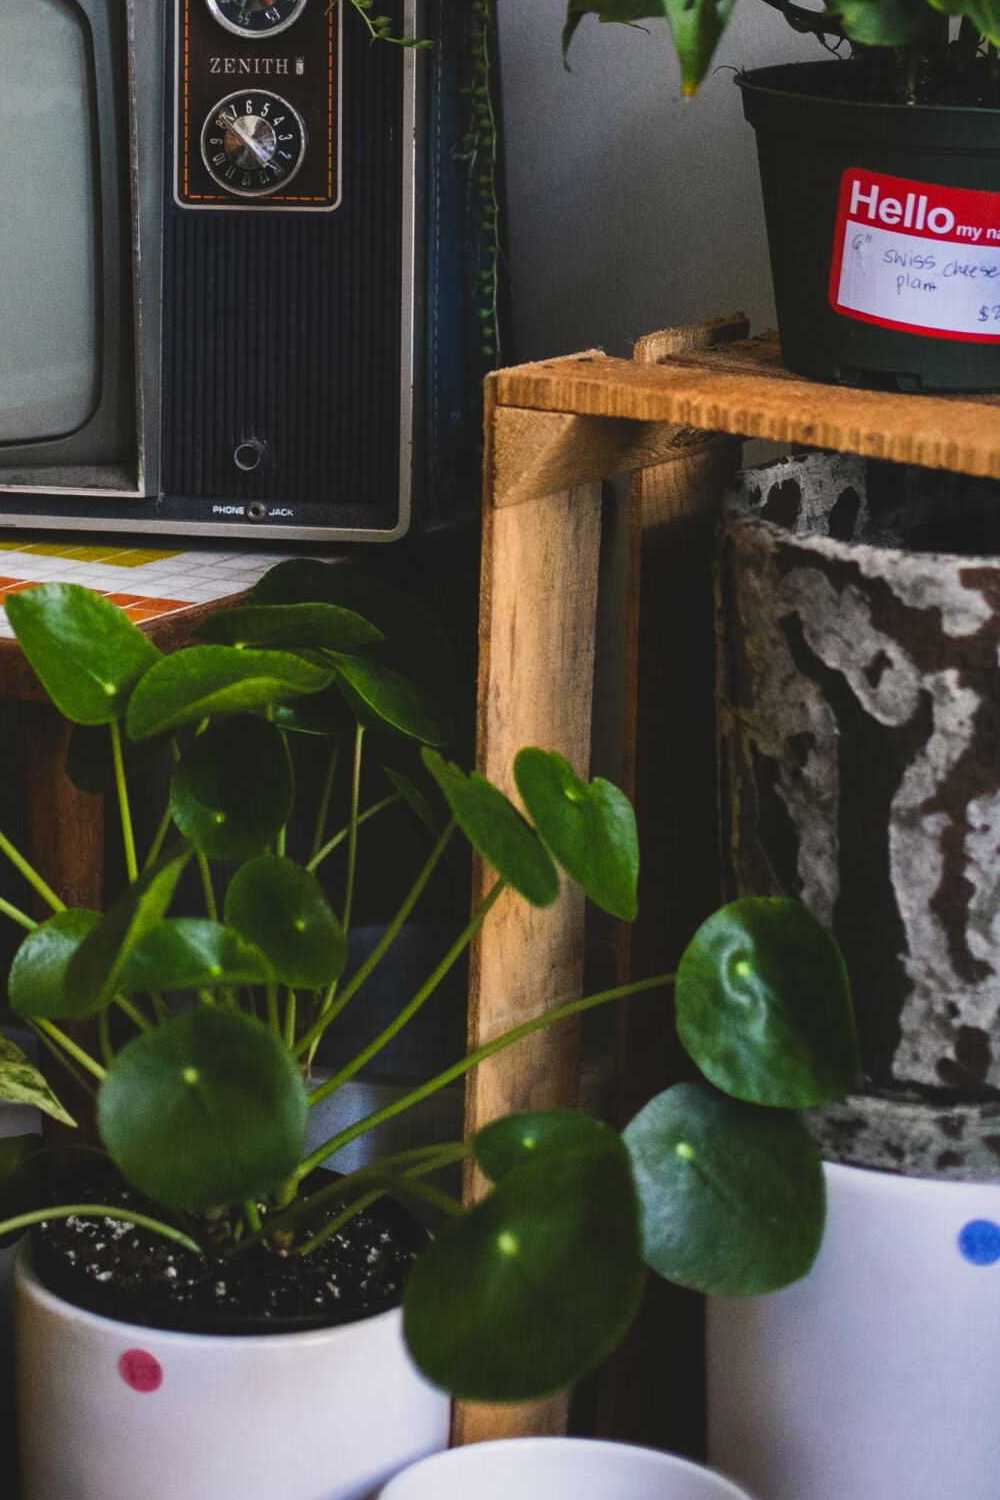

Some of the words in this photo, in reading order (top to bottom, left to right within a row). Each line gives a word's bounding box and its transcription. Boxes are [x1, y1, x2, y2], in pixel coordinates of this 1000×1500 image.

[210, 57, 289, 75] ZENITH
[229, 104, 238, 118] 7
[246, 100, 252, 114] 6
[260, 103, 271, 117] 5
[273, 116, 285, 126] 4
[278, 133, 293, 141] 3
[212, 152, 227, 165] 10
[278, 150, 292, 159] 2
[224, 165, 236, 179] 11
[242, 172, 251, 185] 12
[849, 179, 955, 234] Hello
[956, 225, 982, 241] my
[212, 505, 245, 515] PHONE
[269, 508, 294, 517] JACK
